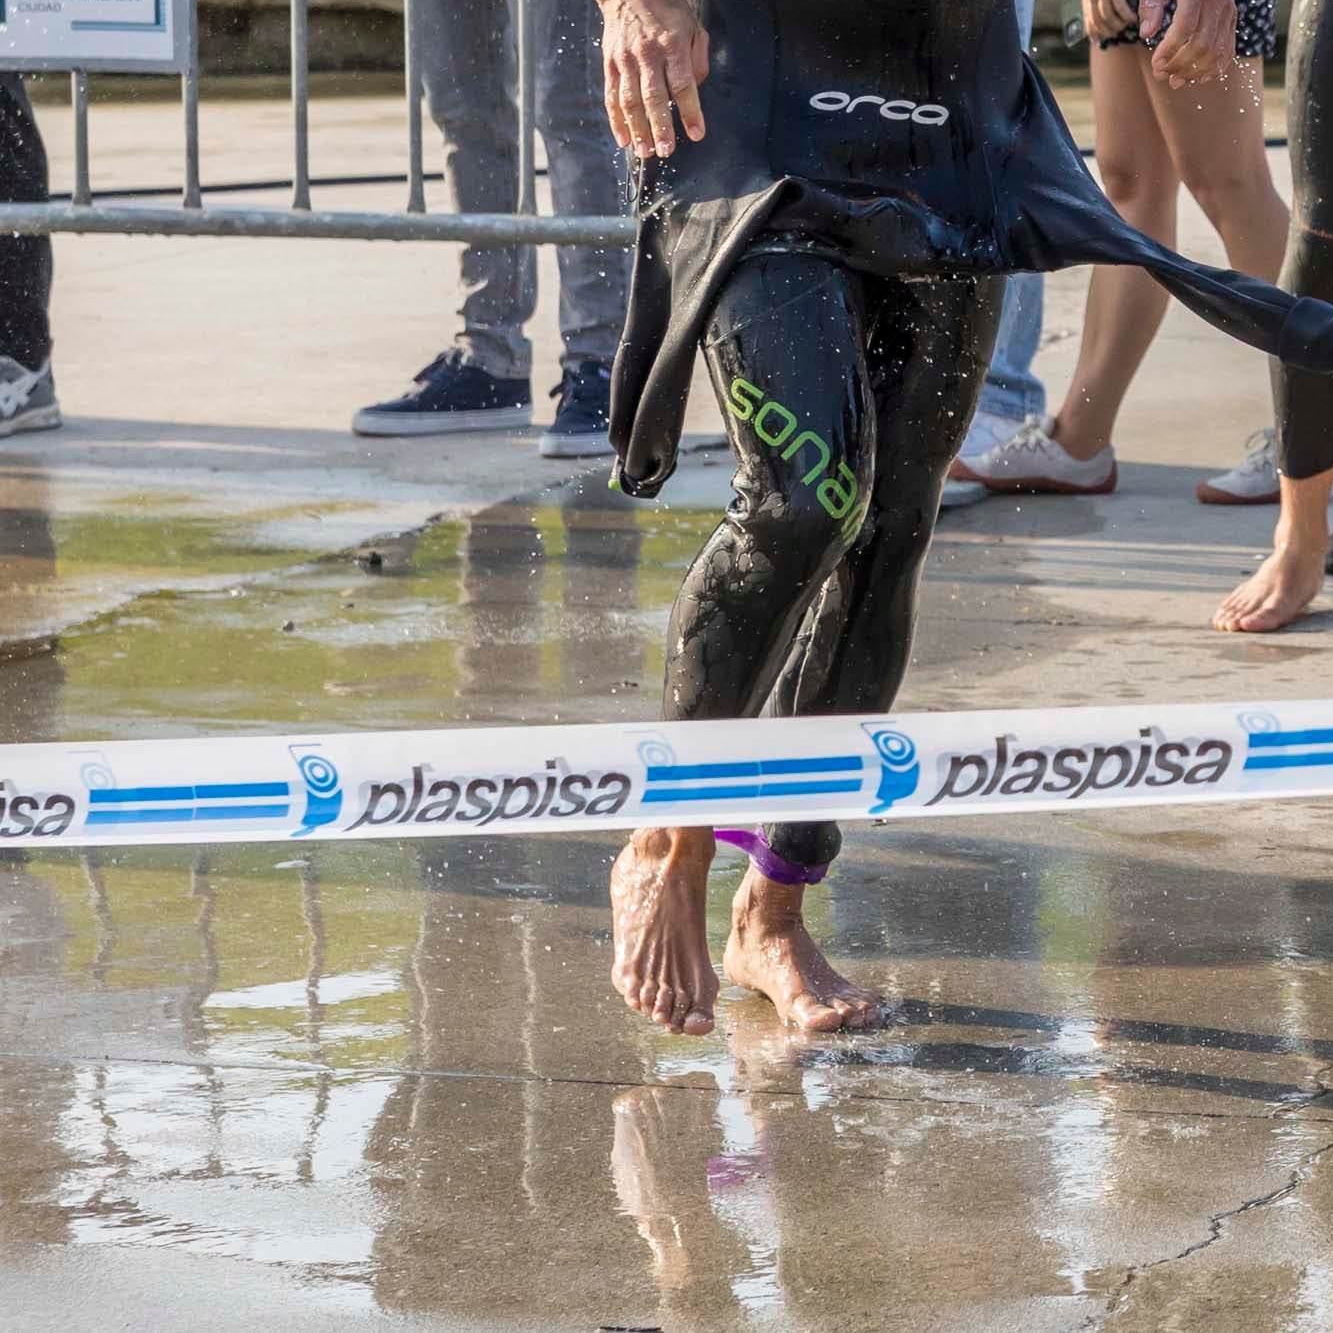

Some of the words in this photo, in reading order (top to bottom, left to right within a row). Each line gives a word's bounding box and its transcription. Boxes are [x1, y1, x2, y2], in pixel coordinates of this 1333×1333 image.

[809, 90, 950, 127] orca
[345, 758, 633, 833] plaspisa
[924, 726, 1233, 807] plaspisa
